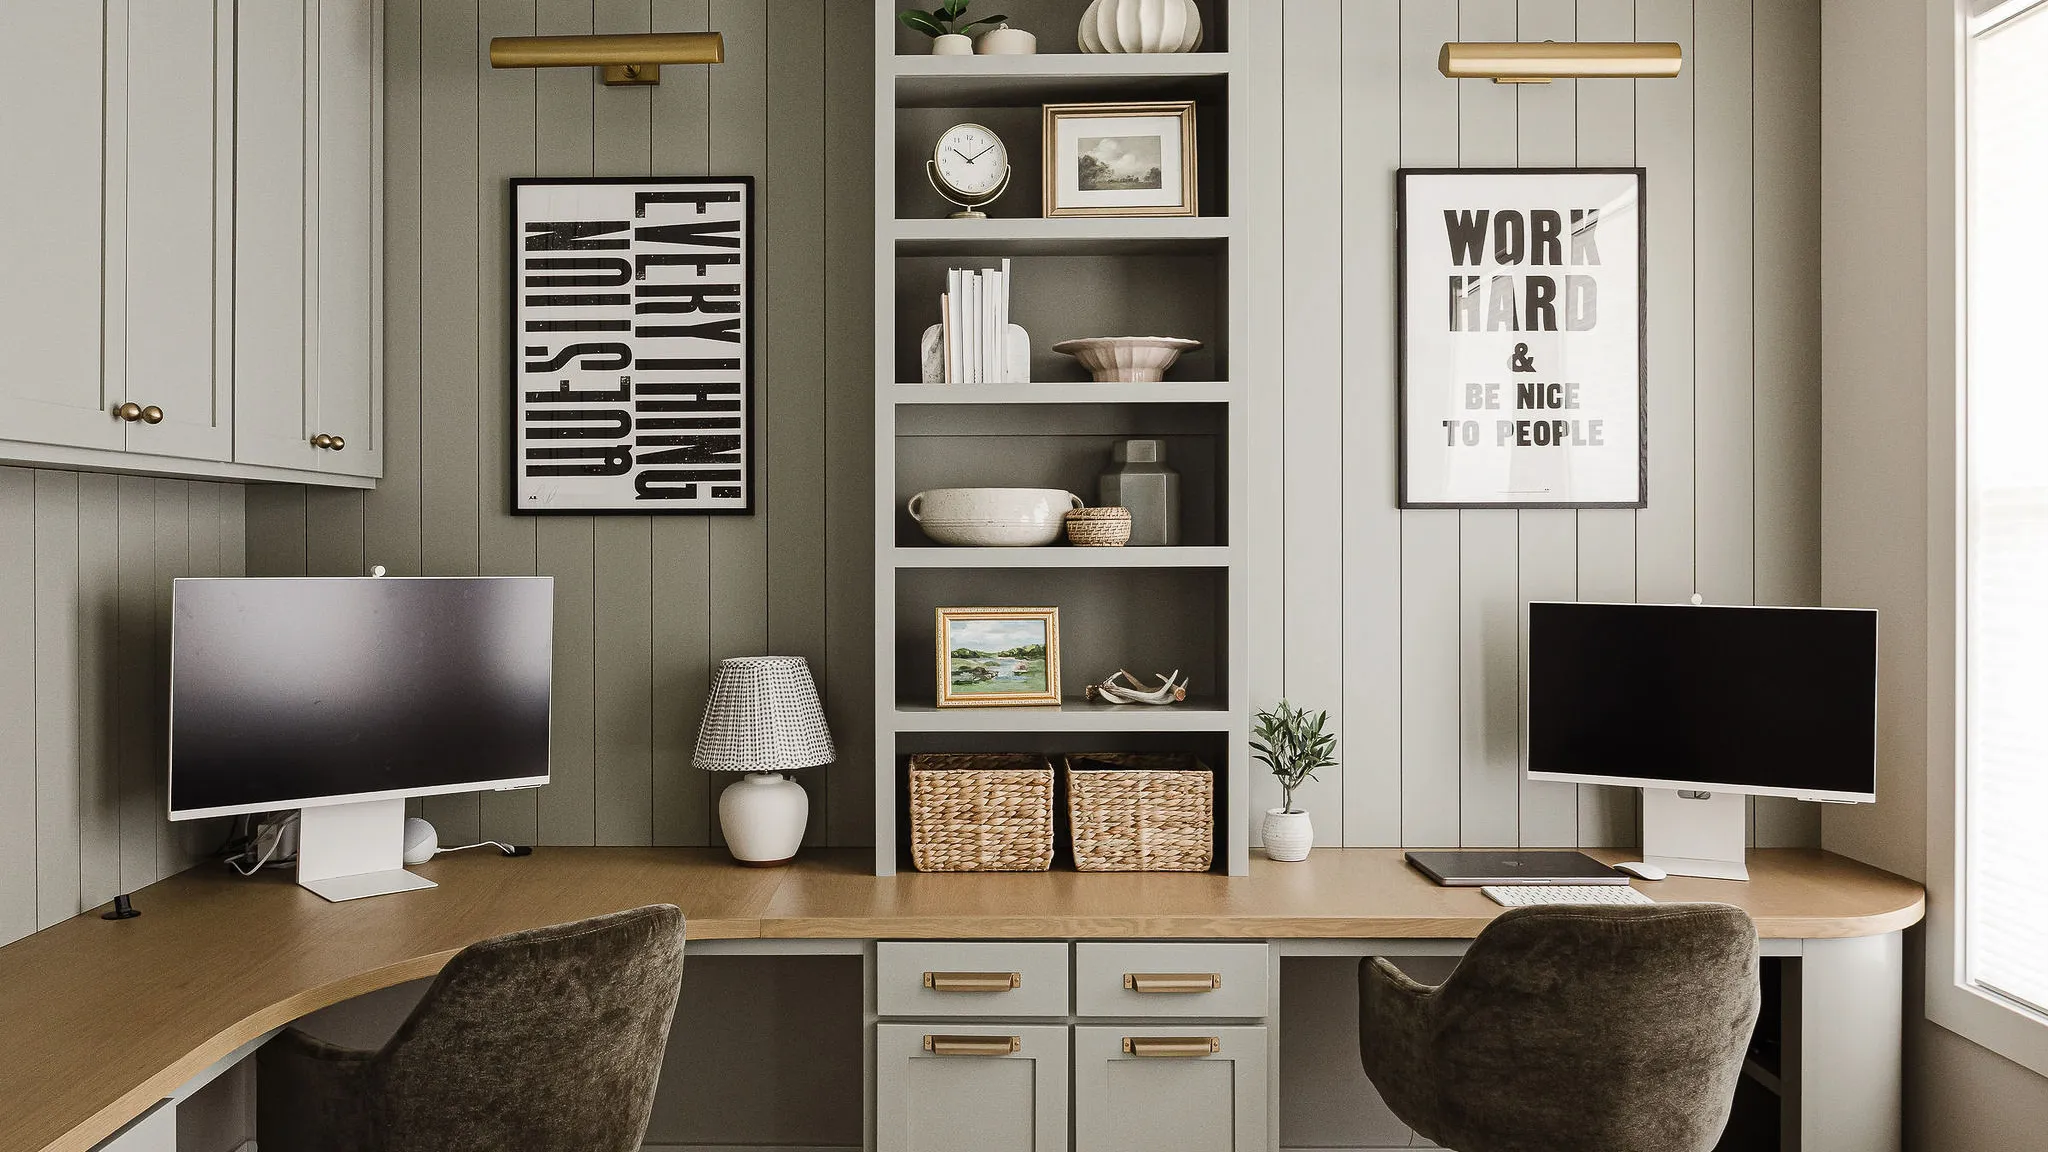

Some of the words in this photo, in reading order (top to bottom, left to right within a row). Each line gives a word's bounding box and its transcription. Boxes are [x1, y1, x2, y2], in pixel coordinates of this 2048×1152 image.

[1443, 209, 1602, 266] WORK
[1449, 275, 1598, 332] HARD
[525, 220, 633, 477] QUESTION
[634, 191, 742, 500] EVERYTHING
[1507, 342, 1537, 373] &
[1465, 383, 1501, 410] BE
[1516, 383, 1580, 410] NICE
[1442, 420, 1480, 447] TO
[1496, 420, 1604, 447] PEOPLE
